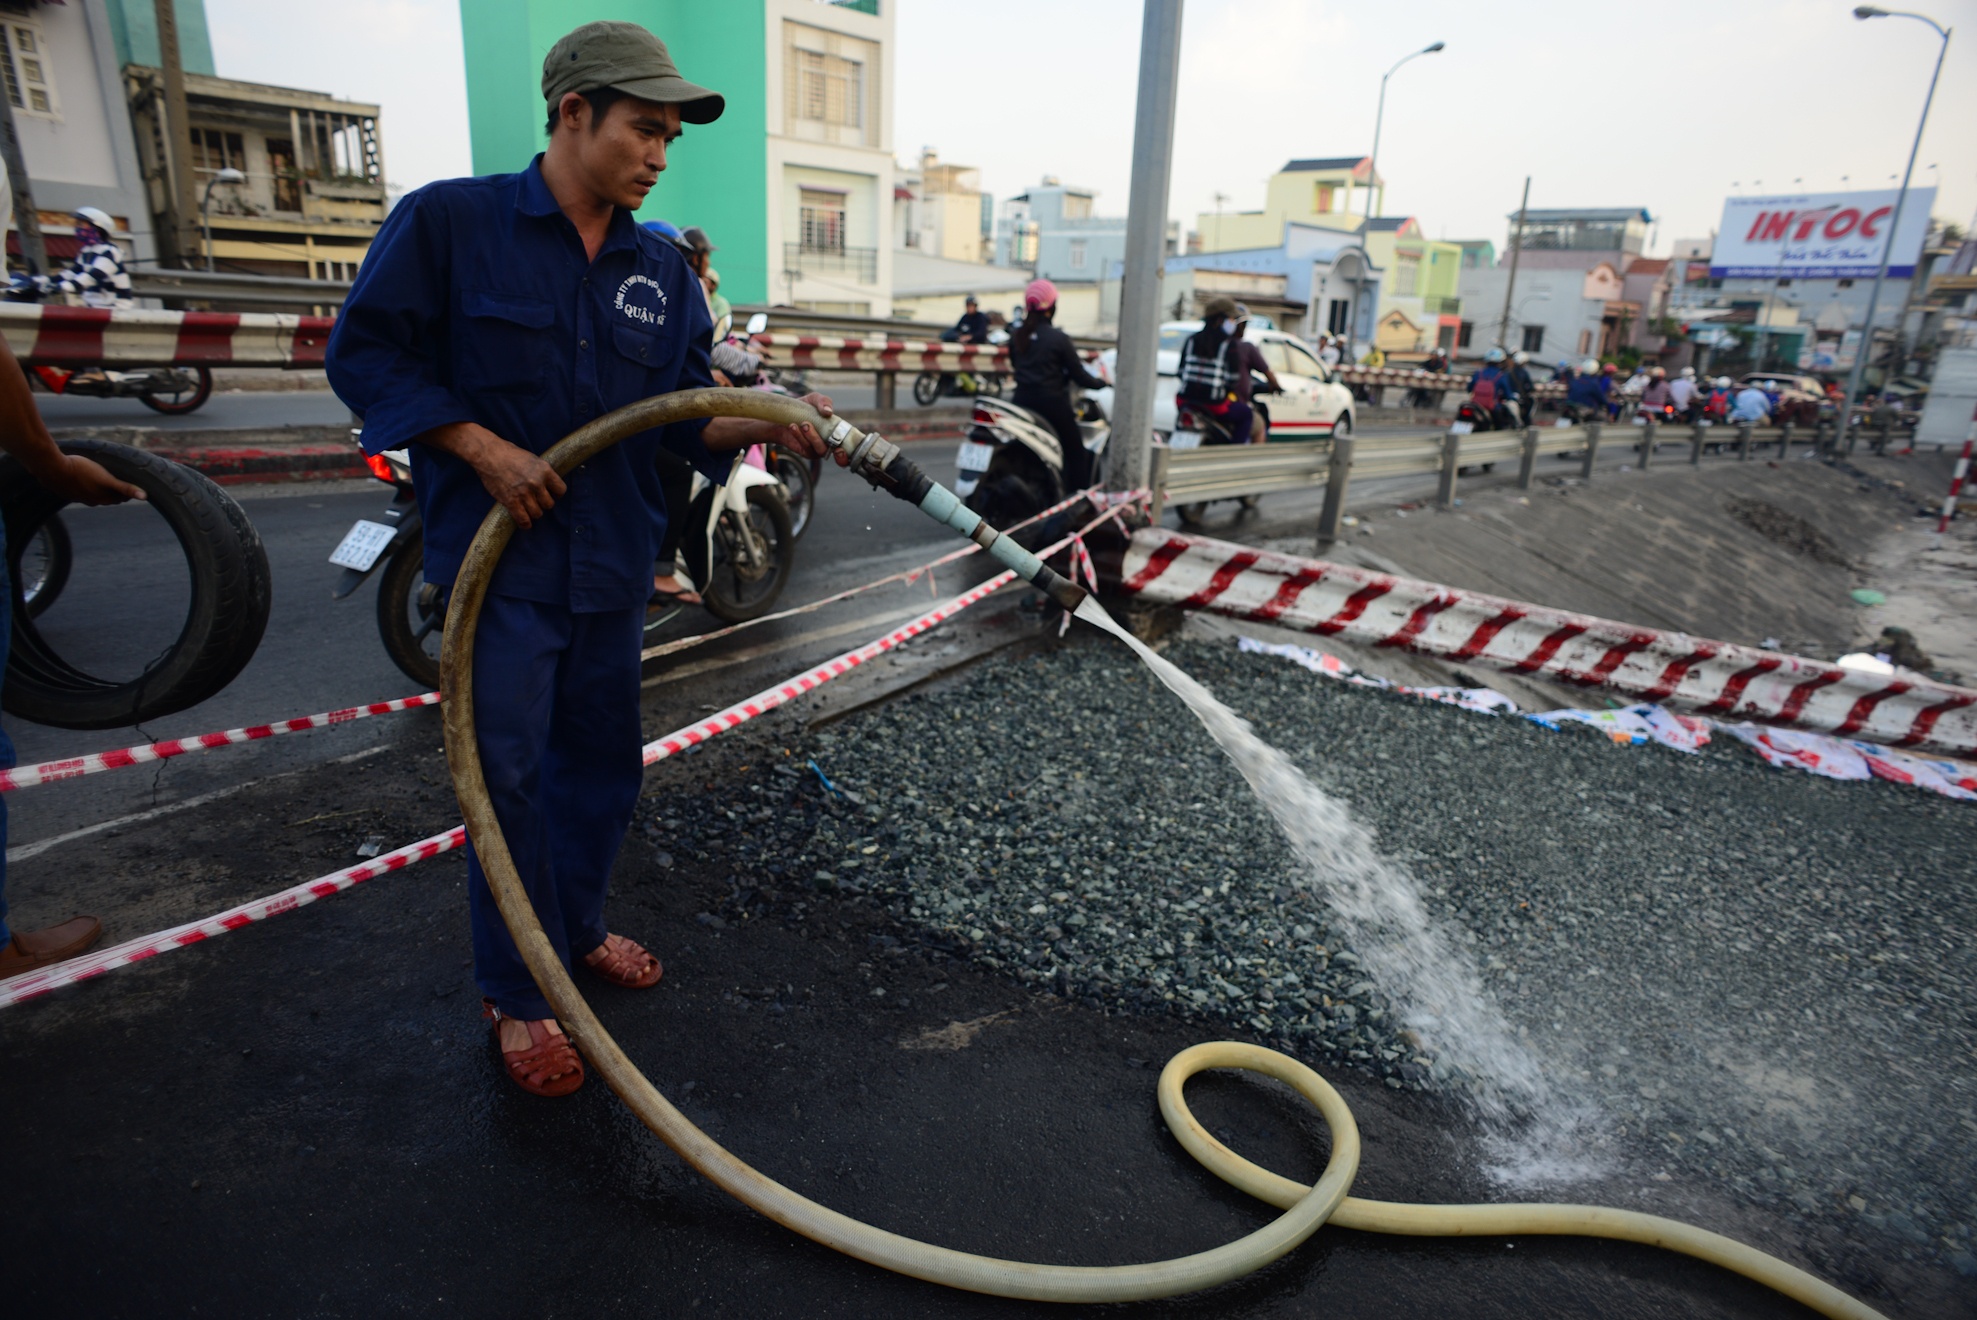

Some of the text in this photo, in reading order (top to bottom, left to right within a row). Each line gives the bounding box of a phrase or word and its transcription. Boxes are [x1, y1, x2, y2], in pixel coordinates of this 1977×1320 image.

[1746, 206, 1893, 242] INTOC
[618, 283, 628, 293] TY
[614, 291, 625, 309] CÔNG
[624, 304, 655, 324] QUẬN
